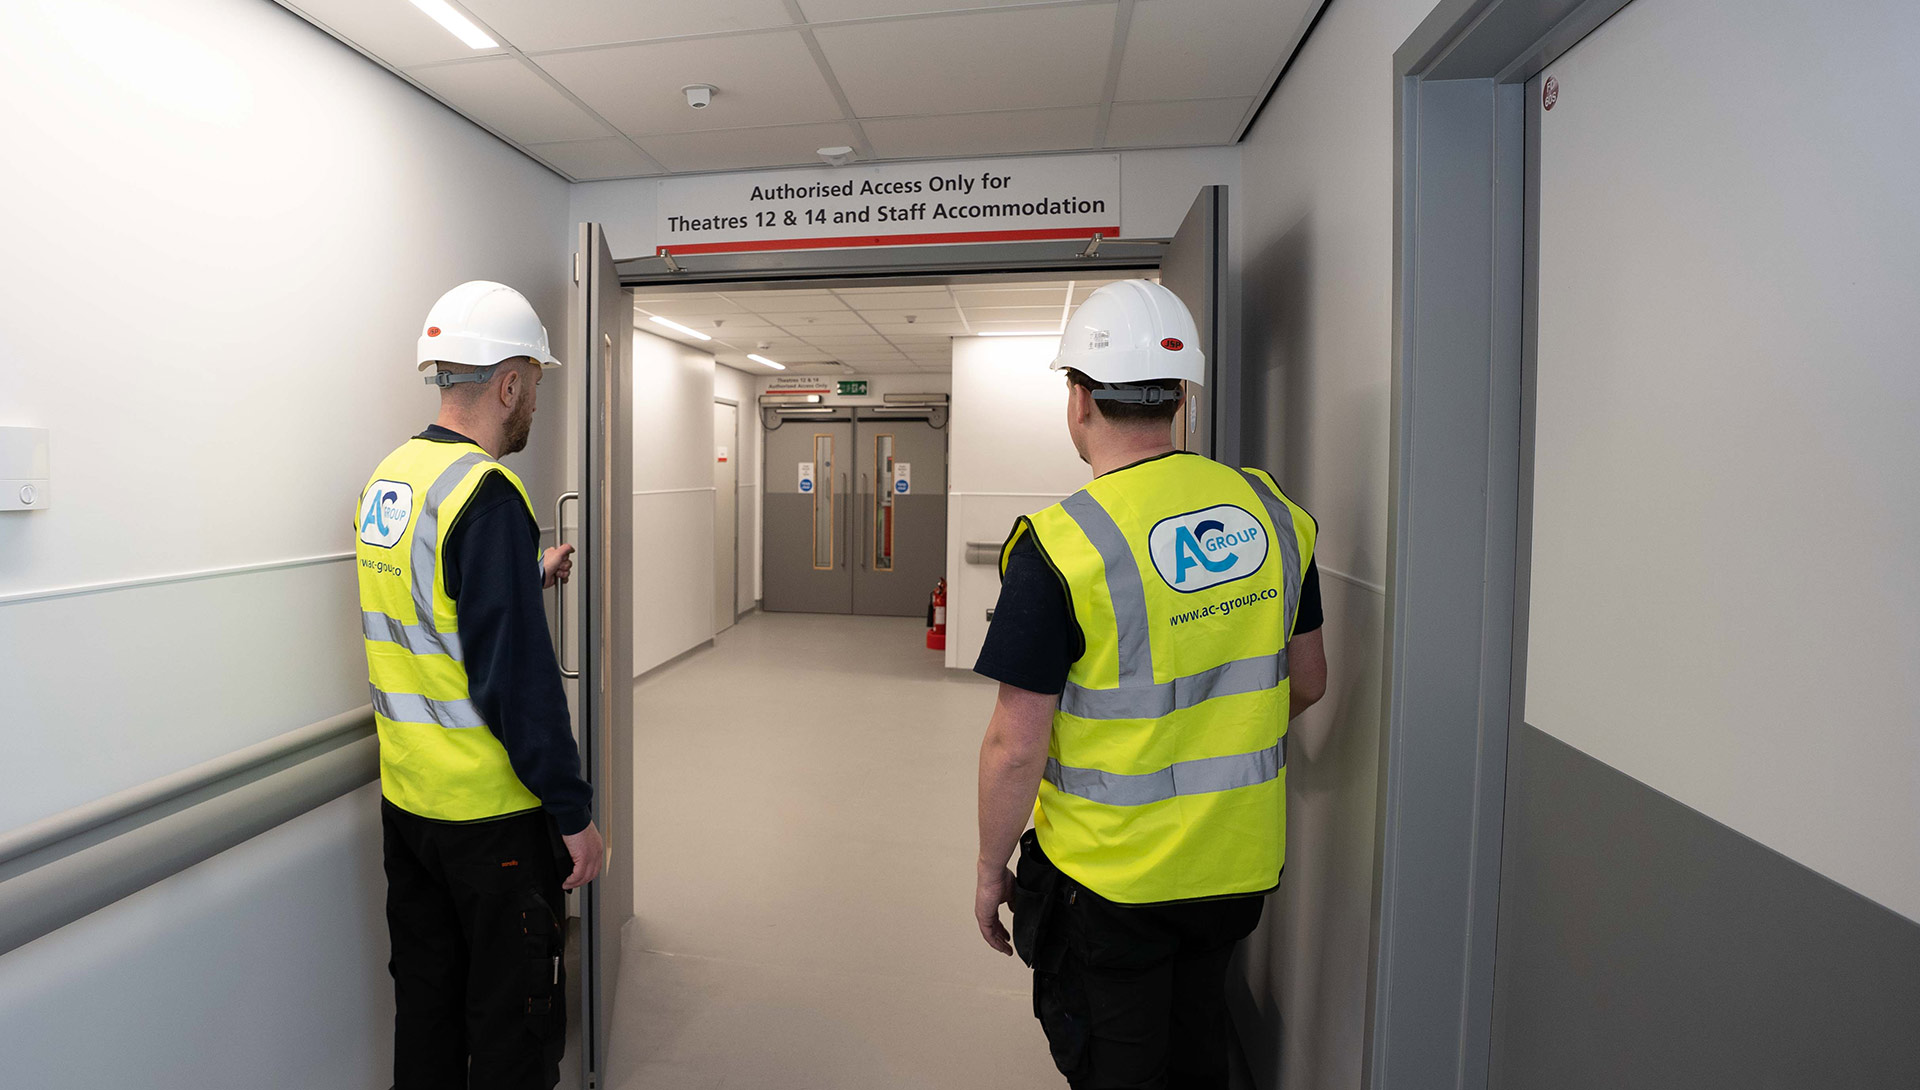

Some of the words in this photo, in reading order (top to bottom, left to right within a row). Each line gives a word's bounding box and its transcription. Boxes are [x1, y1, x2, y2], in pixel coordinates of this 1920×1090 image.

[751, 181, 853, 200] Authorised
[860, 176, 921, 194] Access
[929, 174, 974, 194] Only
[982, 172, 1011, 189] for
[668, 213, 748, 233] Theatres
[755, 211, 776, 227] 12
[783, 209, 798, 226] &
[804, 209, 827, 225] 14
[833, 206, 870, 224] and
[877, 202, 925, 221] Staff
[933, 197, 1105, 219] Accommodation
[1165, 340, 1181, 348] JSP
[1175, 520, 1239, 584] AC
[1206, 528, 1257, 551] GROUP
[1170, 588, 1277, 626] www.ac-group.co
